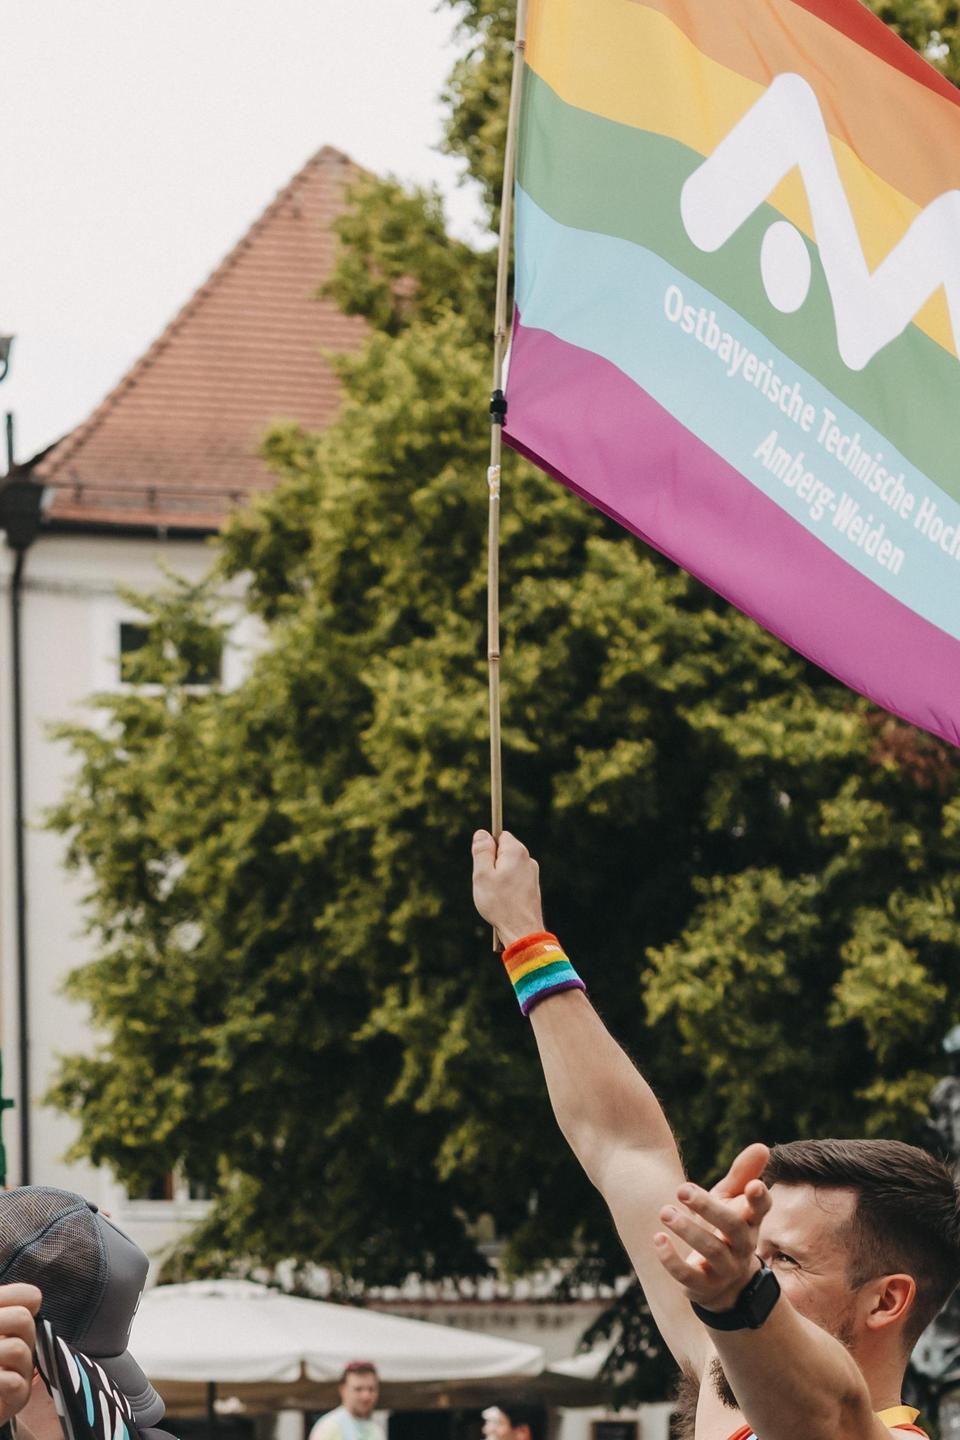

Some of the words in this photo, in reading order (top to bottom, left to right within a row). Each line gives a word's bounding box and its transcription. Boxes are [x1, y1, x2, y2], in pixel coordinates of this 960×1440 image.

[664, 285, 816, 432] Ostbayerische
[817, 406, 914, 519] Technische
[753, 429, 906, 576] Amberg-Weiden
